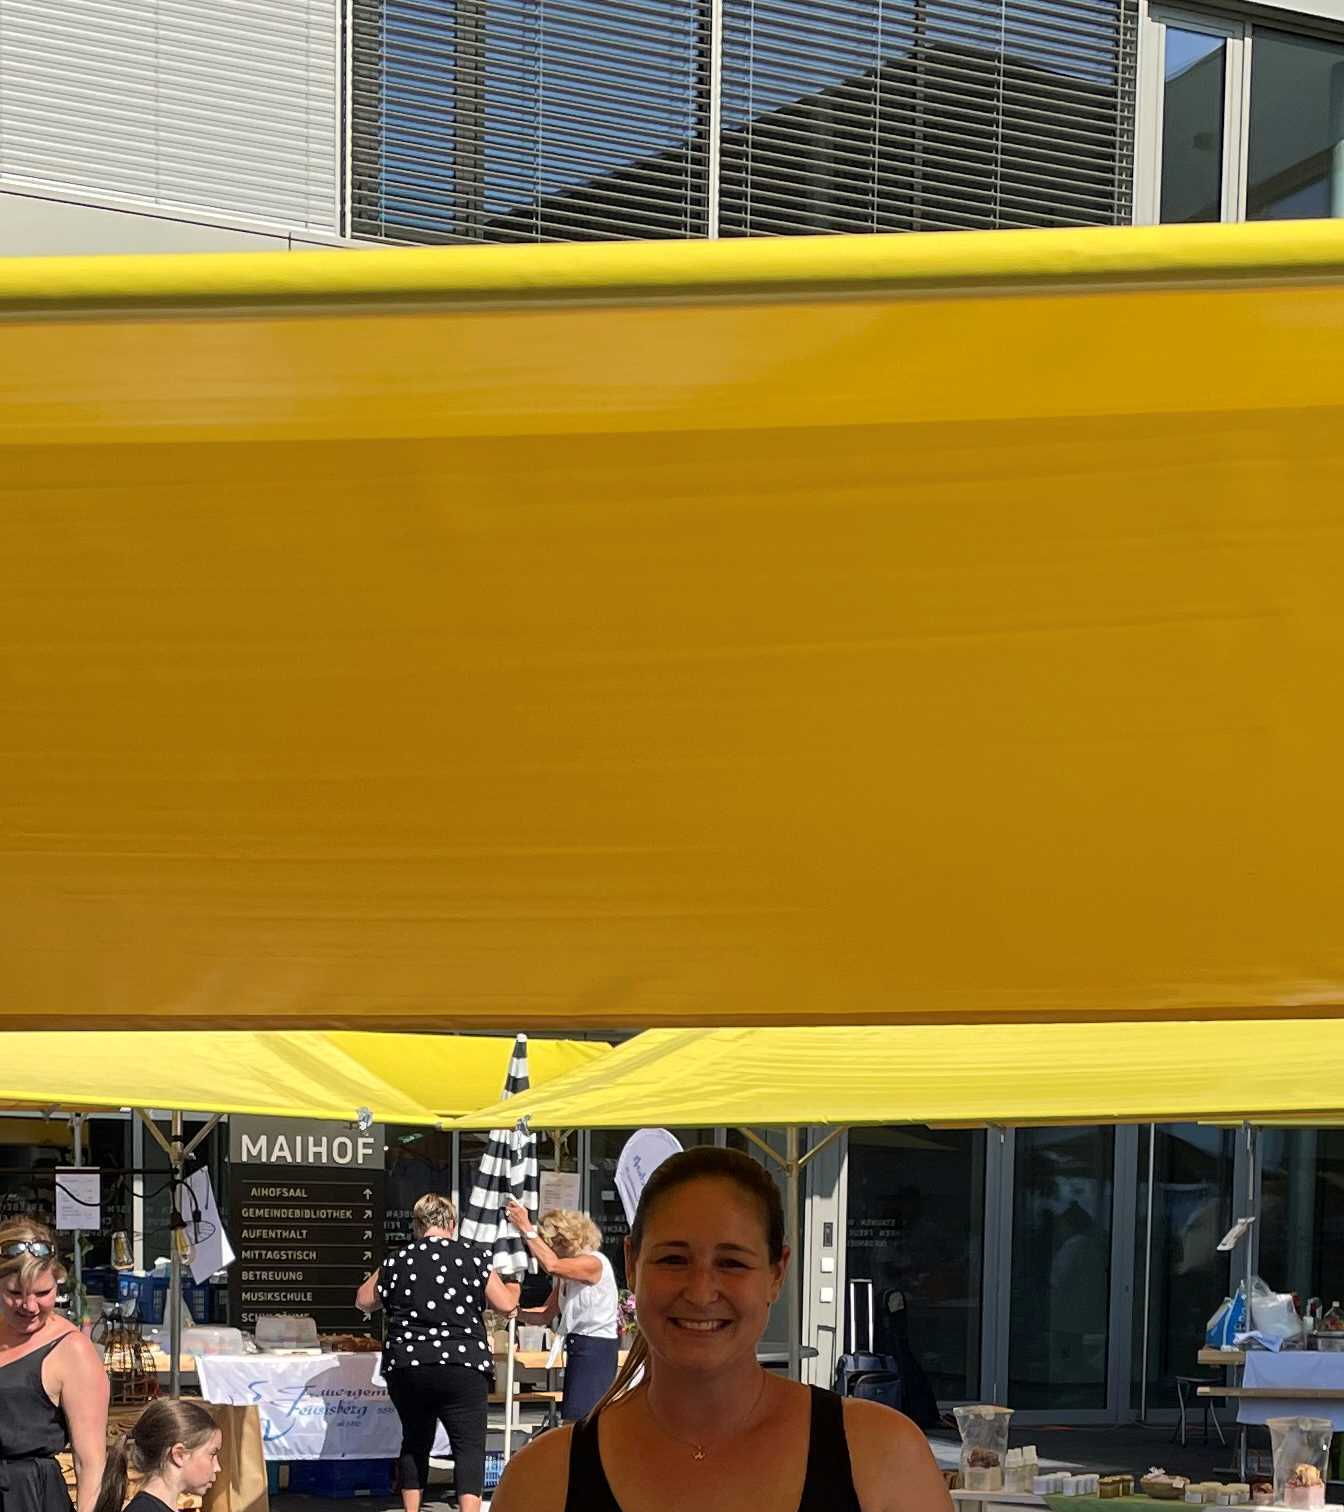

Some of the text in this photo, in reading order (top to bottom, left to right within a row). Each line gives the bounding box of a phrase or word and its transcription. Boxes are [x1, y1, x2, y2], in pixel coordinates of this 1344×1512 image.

[241, 1134, 375, 1164] MAIHOF
[242, 1208, 352, 1219] GEMEINDEBIBLIOTHEK
[242, 1229, 308, 1239] AUFENTHALT
[242, 1250, 317, 1260] MITTAGSTISCH
[242, 1271, 303, 1281] BETREUUNG
[242, 1292, 313, 1301] MUSIKSCHULE
